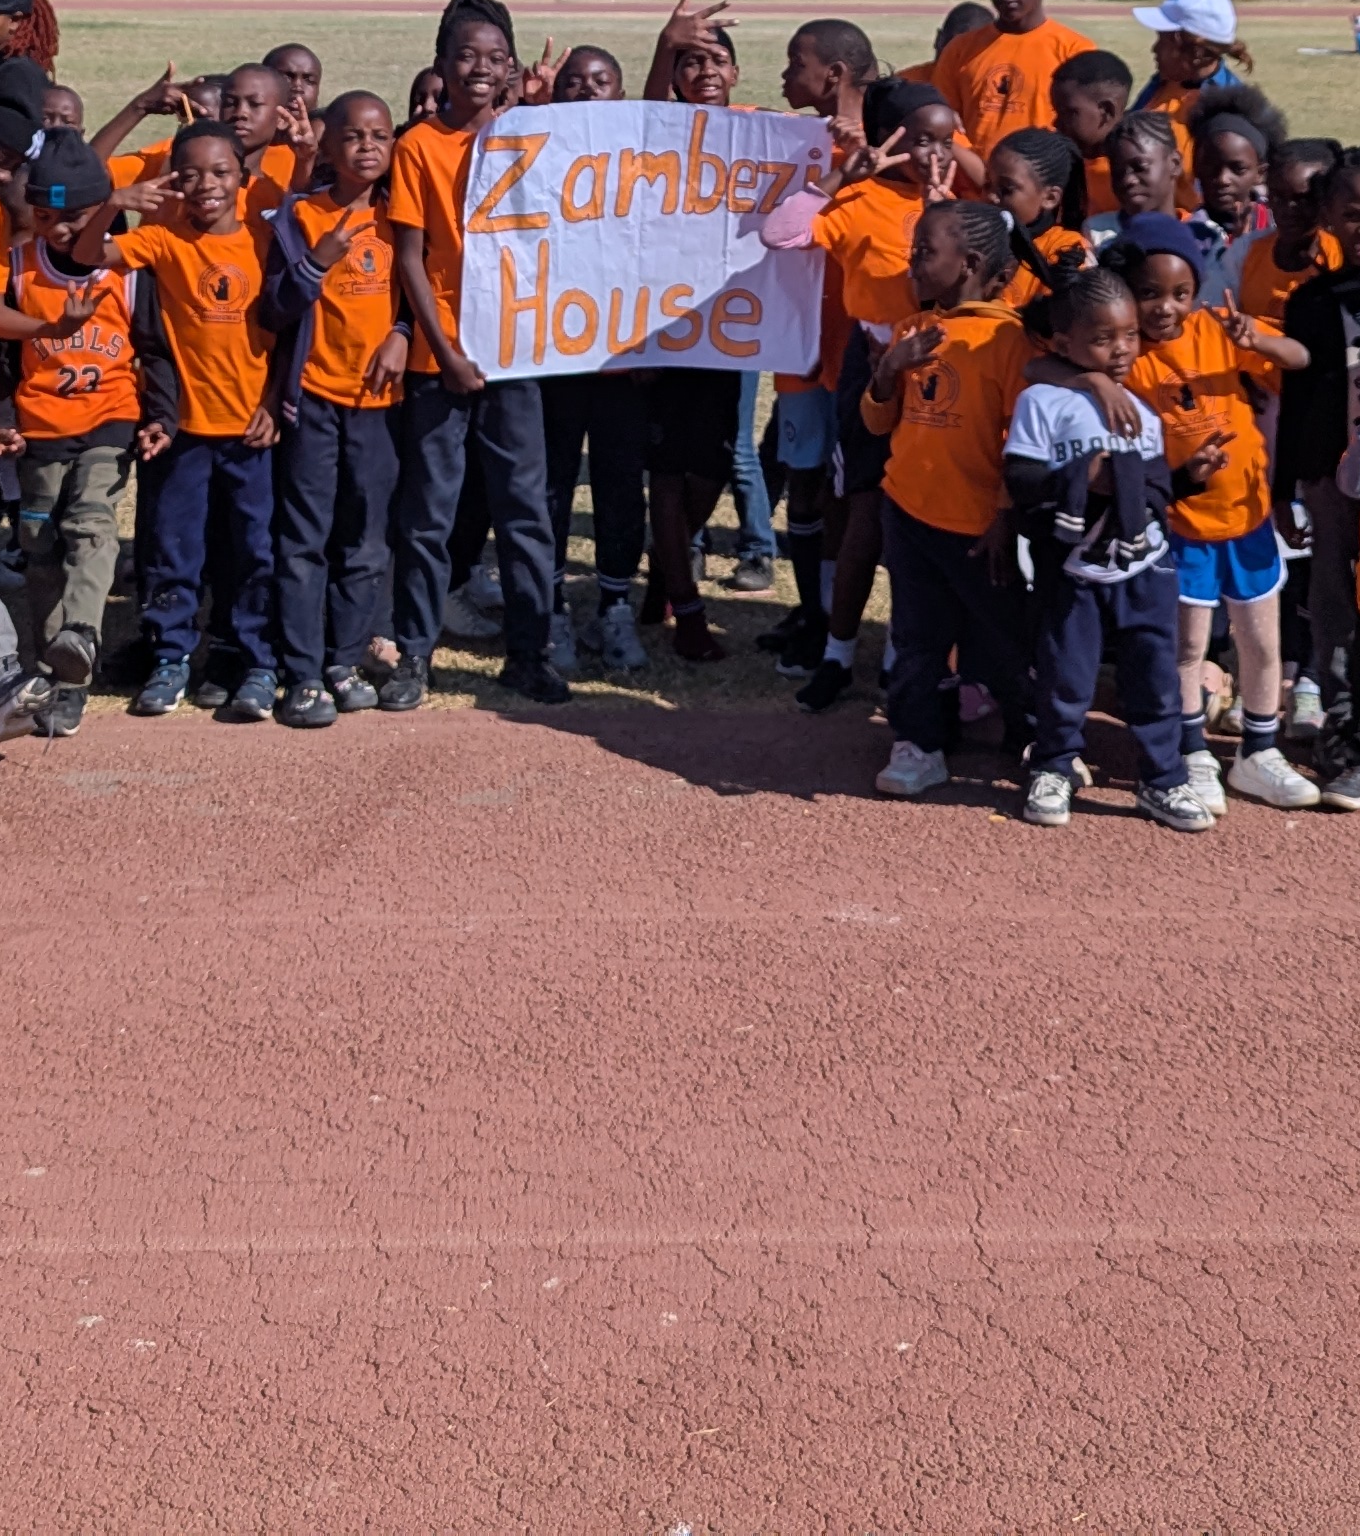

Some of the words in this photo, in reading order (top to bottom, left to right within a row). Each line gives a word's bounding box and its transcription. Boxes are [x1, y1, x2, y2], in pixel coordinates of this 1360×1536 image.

[466, 109, 823, 234] Zambezi
[499, 239, 762, 369] House
[58, 366, 100, 395] 23
